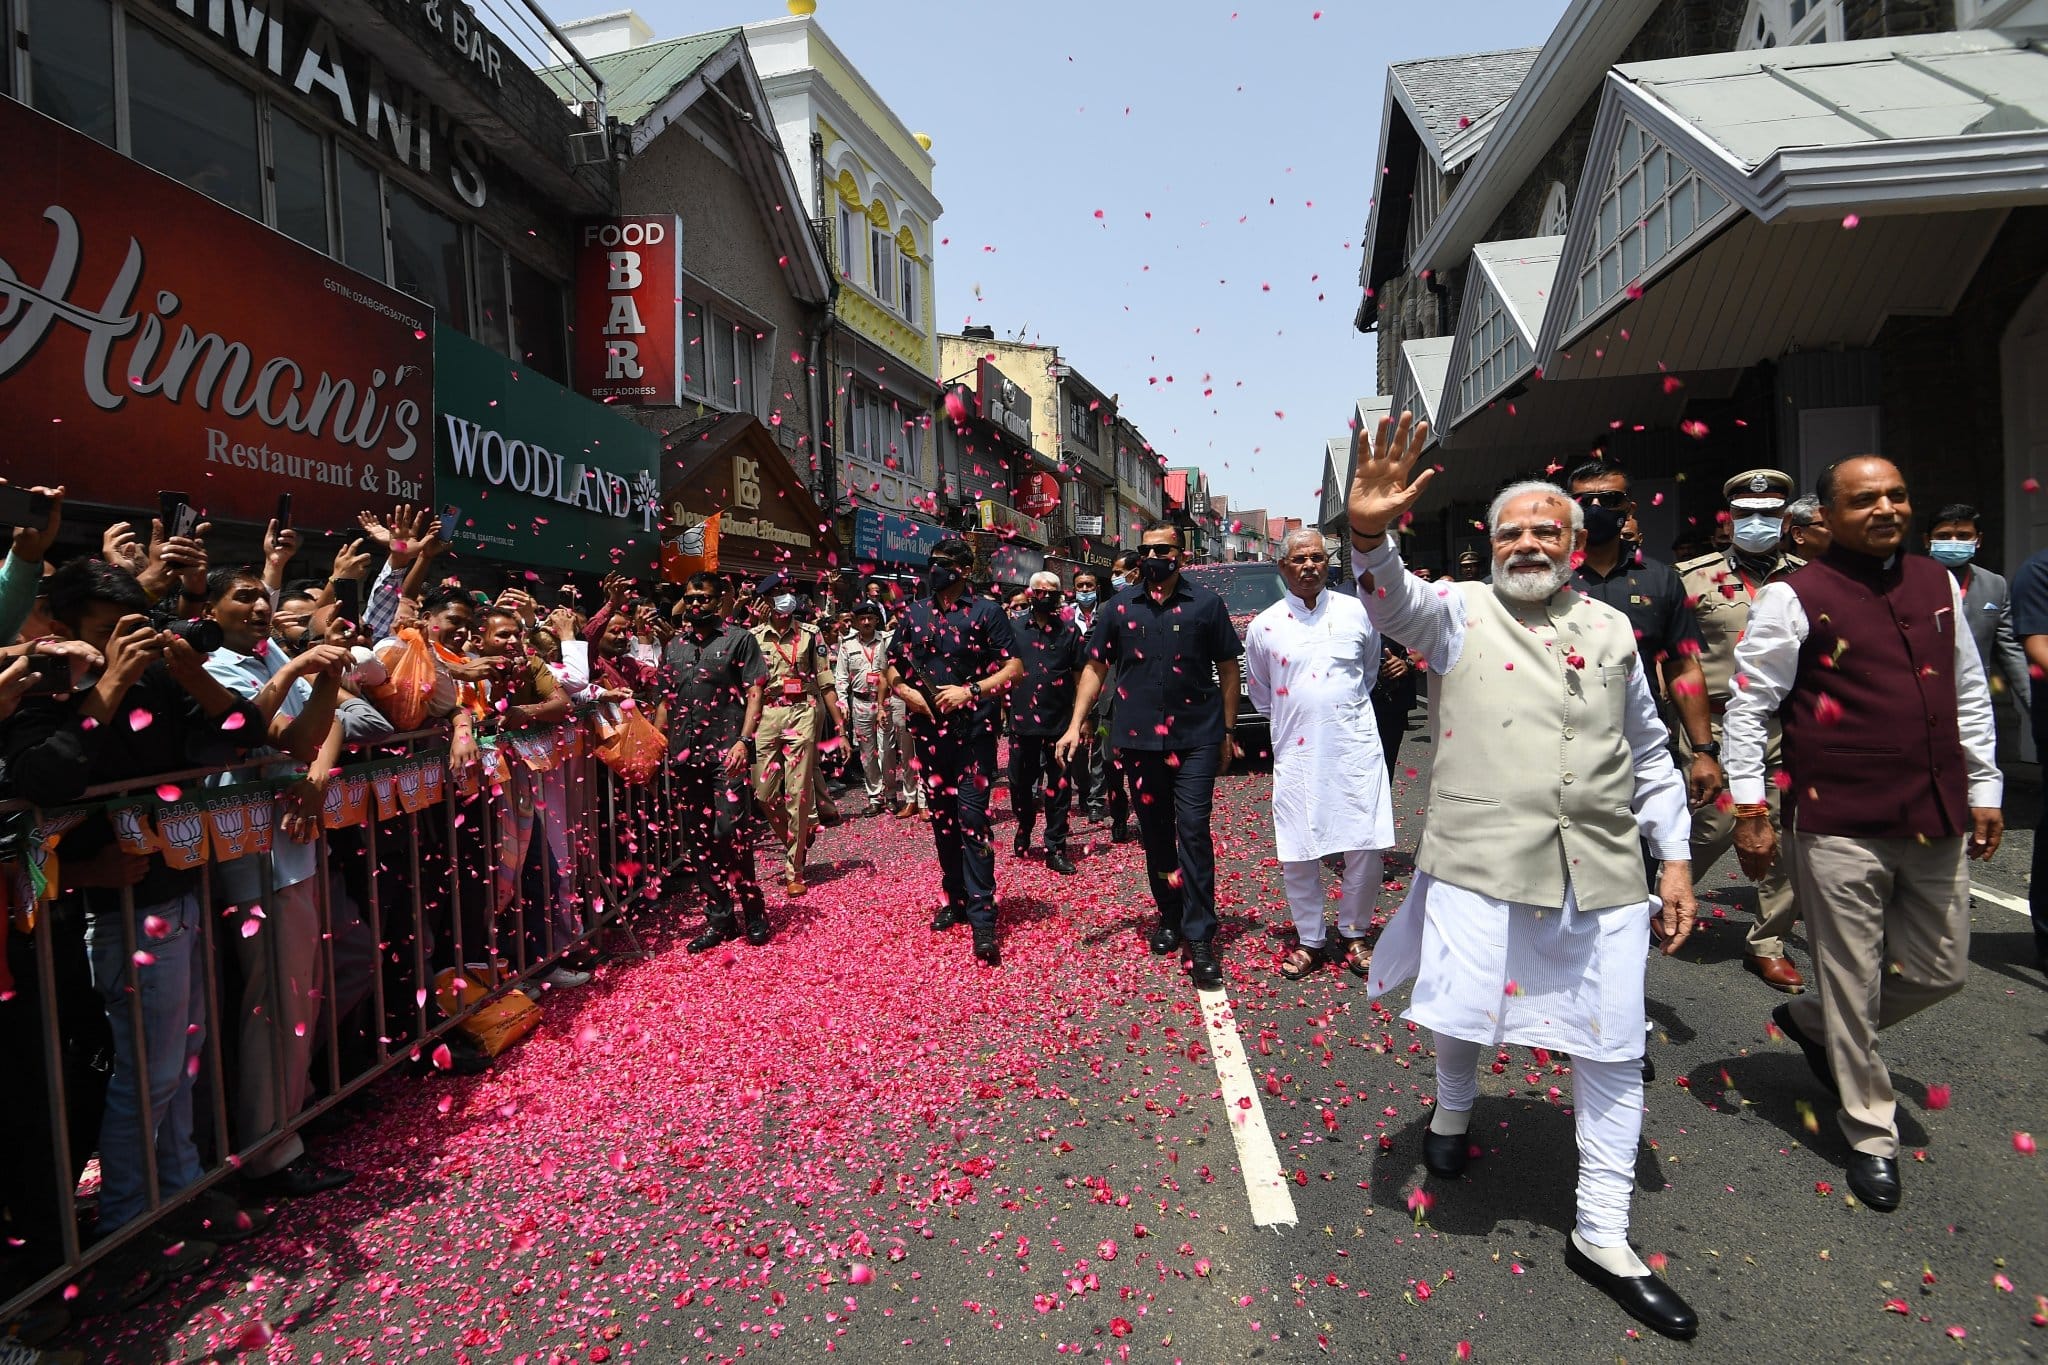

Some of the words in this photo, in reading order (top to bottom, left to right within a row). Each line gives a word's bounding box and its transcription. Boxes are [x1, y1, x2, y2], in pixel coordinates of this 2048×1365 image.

[453, 11, 502, 87] BAR
[176, 0, 487, 208] MANI'S
[584, 223, 665, 247] FOOD
[323, 278, 352, 299] GSTIN:
[602, 251, 646, 379] BAR
[0, 205, 421, 461] Himani's
[592, 388, 613, 396] BEST
[616, 386, 657, 396] ADDRESS
[205, 428, 353, 487] Restaurant
[360, 463, 379, 493] &
[386, 468, 422, 501] Bar
[444, 413, 631, 518] WOODLAND
[886, 530, 917, 553] Minerva
[159, 802, 199, 820] B.J.P.
